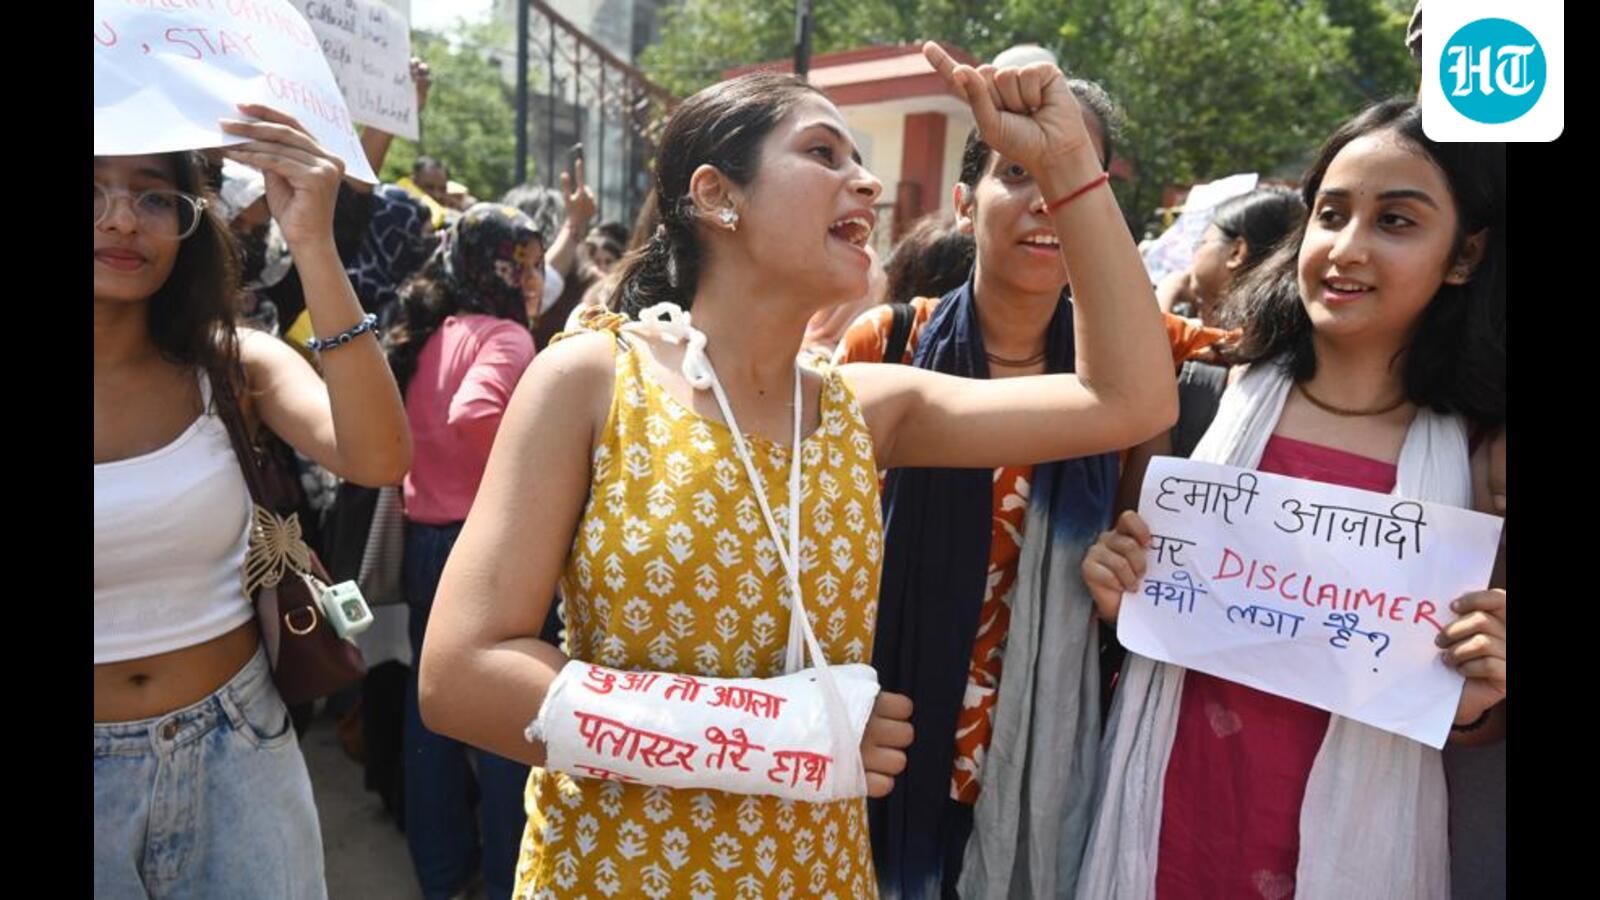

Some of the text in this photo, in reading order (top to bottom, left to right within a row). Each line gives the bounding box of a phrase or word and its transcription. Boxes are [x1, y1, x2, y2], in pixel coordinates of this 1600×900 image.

[1155, 472, 1427, 560] हमारी आज़ादी
[1143, 570, 1208, 613] क्यों
[1226, 604, 1304, 638] लगा
[1150, 534, 1446, 632] पर DISCLAIMER
[707, 686, 788, 720] अगला
[574, 710, 699, 773] पलास्टर
[767, 750, 834, 791] हाथ
